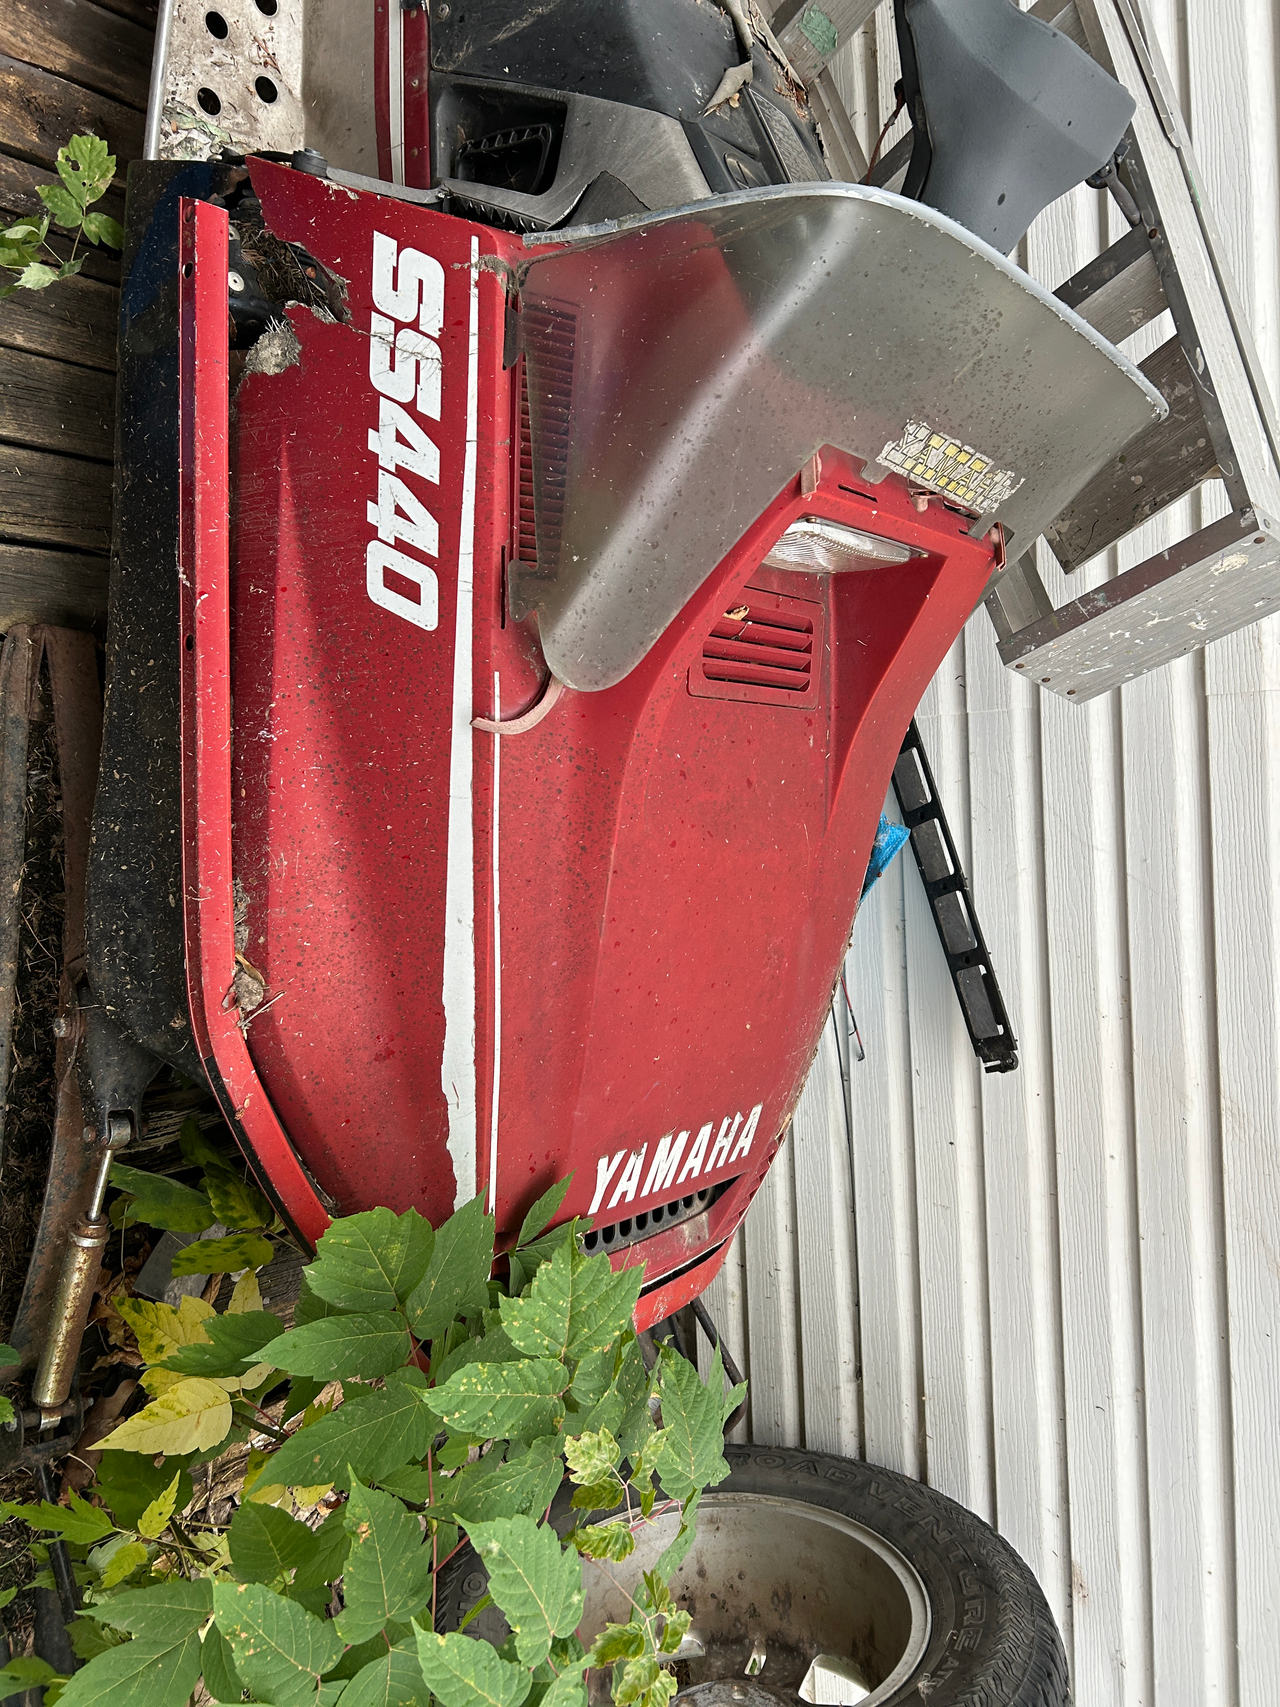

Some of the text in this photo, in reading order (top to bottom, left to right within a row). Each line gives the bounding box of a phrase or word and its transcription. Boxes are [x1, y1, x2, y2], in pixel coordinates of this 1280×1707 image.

[367, 230, 445, 631] SS440
[885, 423, 1012, 512] YAMAHA
[587, 1102, 763, 1215] YAMAHA
[869, 1480, 986, 1652] VENTURE
